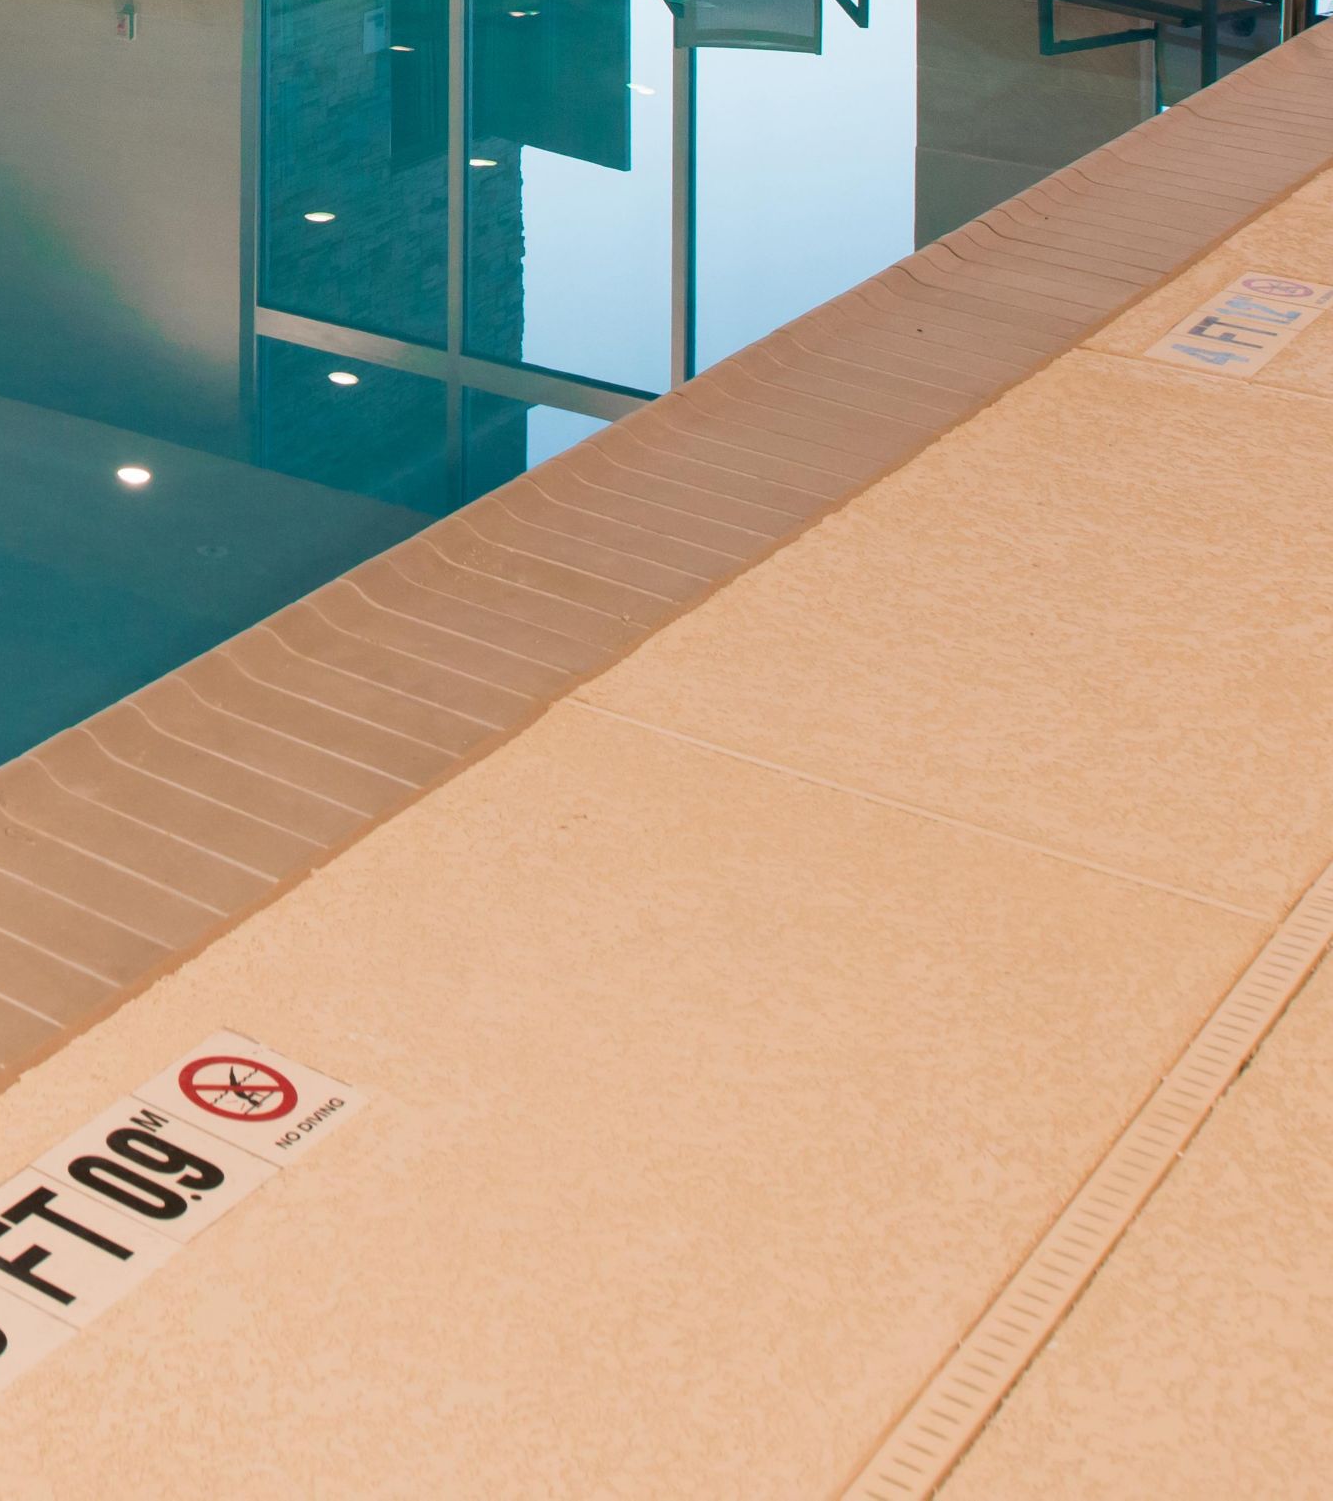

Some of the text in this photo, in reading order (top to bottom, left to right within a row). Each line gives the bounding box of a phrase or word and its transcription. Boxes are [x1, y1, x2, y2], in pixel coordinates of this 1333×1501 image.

[1188, 315, 1279, 349] FT
[274, 1097, 345, 1150] NO DIVING
